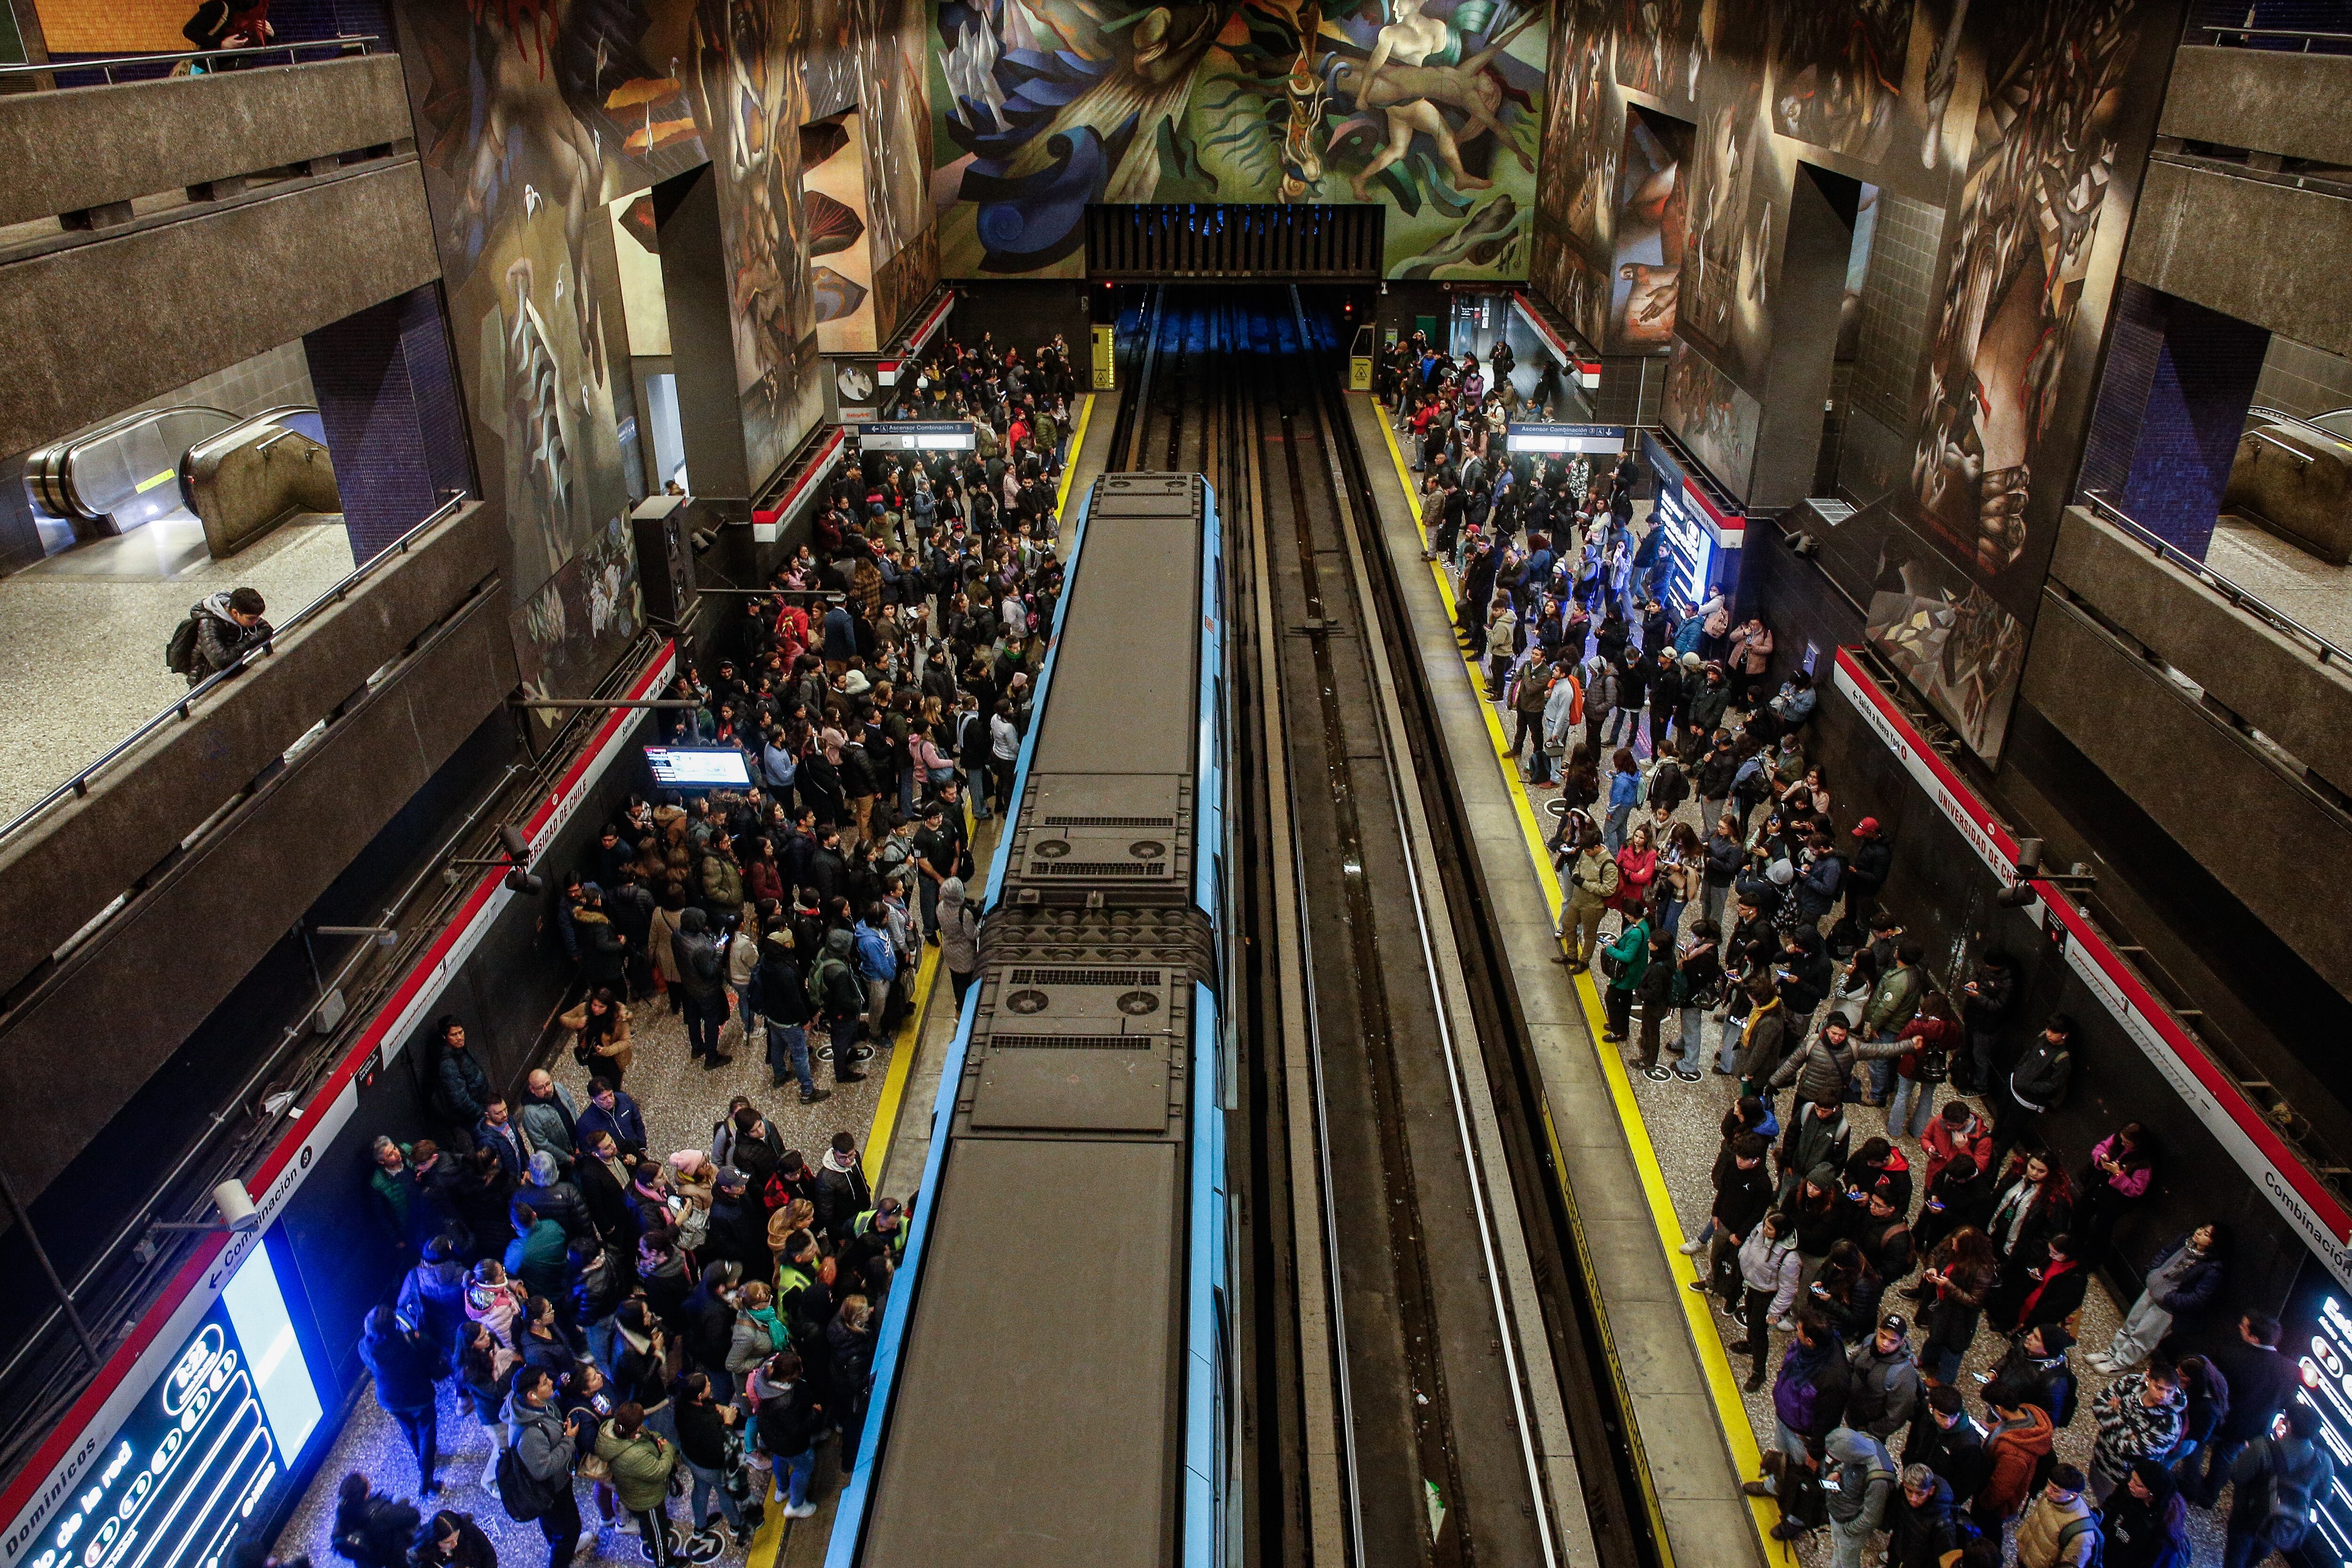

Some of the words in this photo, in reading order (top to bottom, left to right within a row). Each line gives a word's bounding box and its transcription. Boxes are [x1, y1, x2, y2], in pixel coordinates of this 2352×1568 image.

[1859, 695, 1871, 717] Salida
[1872, 714, 1876, 722] a
[1876, 716, 1890, 739] Nueva
[1890, 732, 1900, 752] York
[560, 804, 568, 824] DE
[569, 779, 587, 810] CHILE
[1938, 788, 1986, 854] UNIVERSIDAD
[1988, 848, 1999, 870] DE
[224, 1168, 297, 1266] Cominación
[5, 1438, 95, 1559] Dominicos
[57, 1512, 83, 1549] de
[80, 1486, 103, 1515] la
[101, 1440, 133, 1489] red
